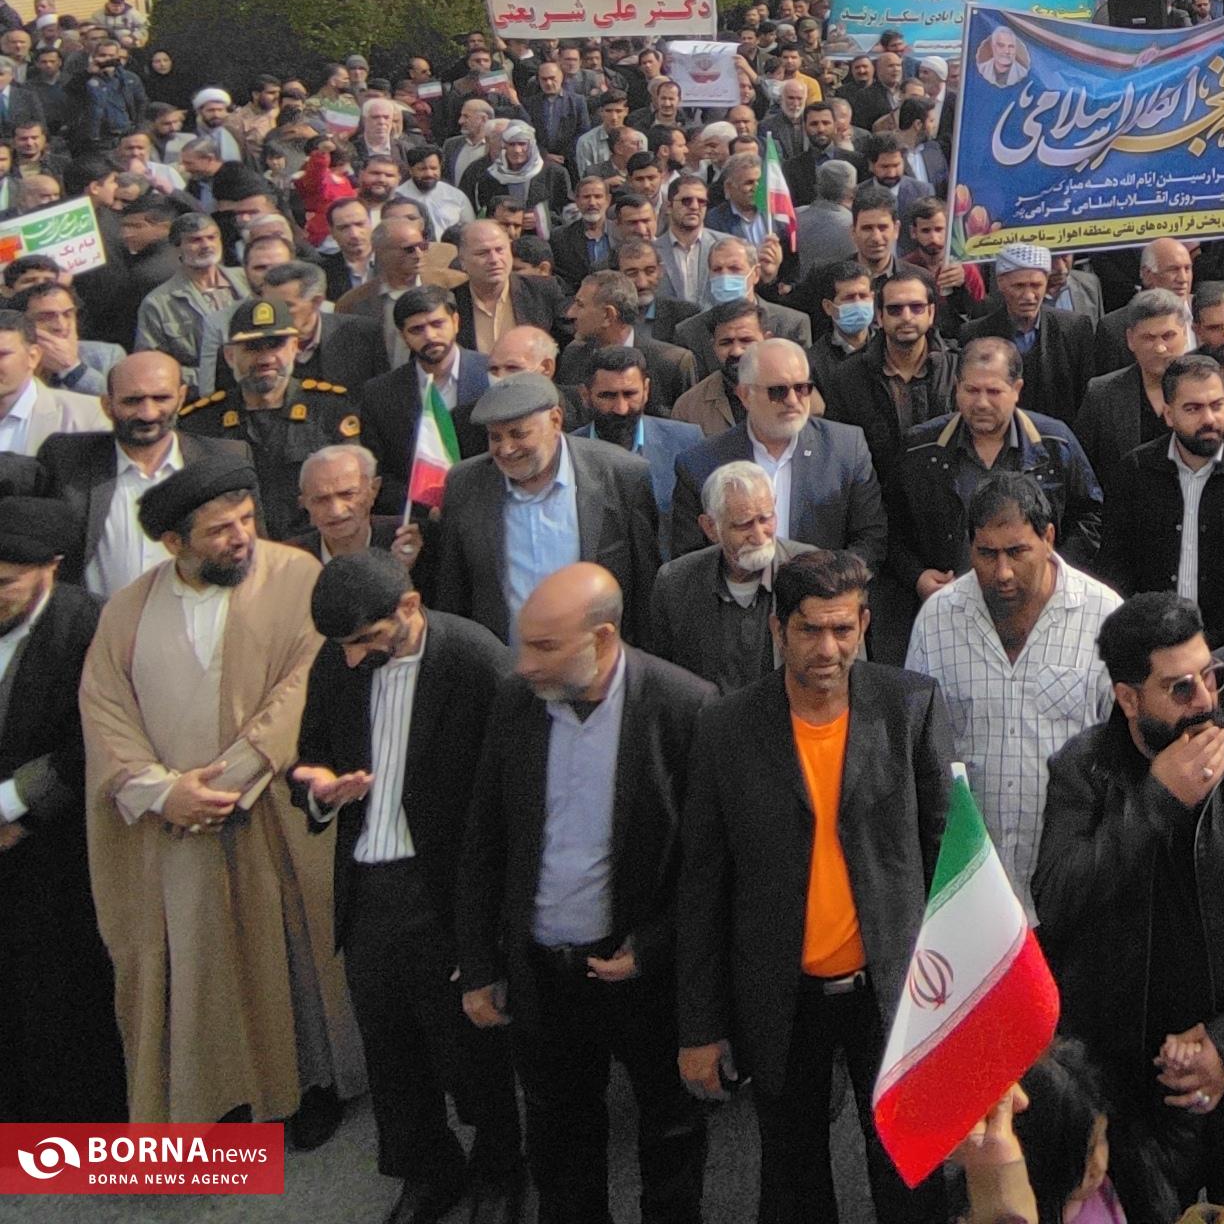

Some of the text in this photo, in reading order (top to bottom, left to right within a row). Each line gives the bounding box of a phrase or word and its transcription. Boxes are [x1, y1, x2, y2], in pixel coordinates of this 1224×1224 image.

[494, 0, 586, 30] شریعتی
[593, 0, 638, 29] علی
[1053, 179, 1084, 195] مبارک
[1085, 176, 1119, 189] دهه
[1120, 174, 1136, 187] الله
[1072, 194, 1117, 215] اسلامی
[1117, 190, 1169, 210] انقلاب
[1025, 199, 1072, 219] گرامی
[1083, 225, 1111, 236] منطقه
[1112, 223, 1135, 237] نفتی
[1197, 215, 1221, 230] پخش
[1058, 227, 1082, 243] اهواز
